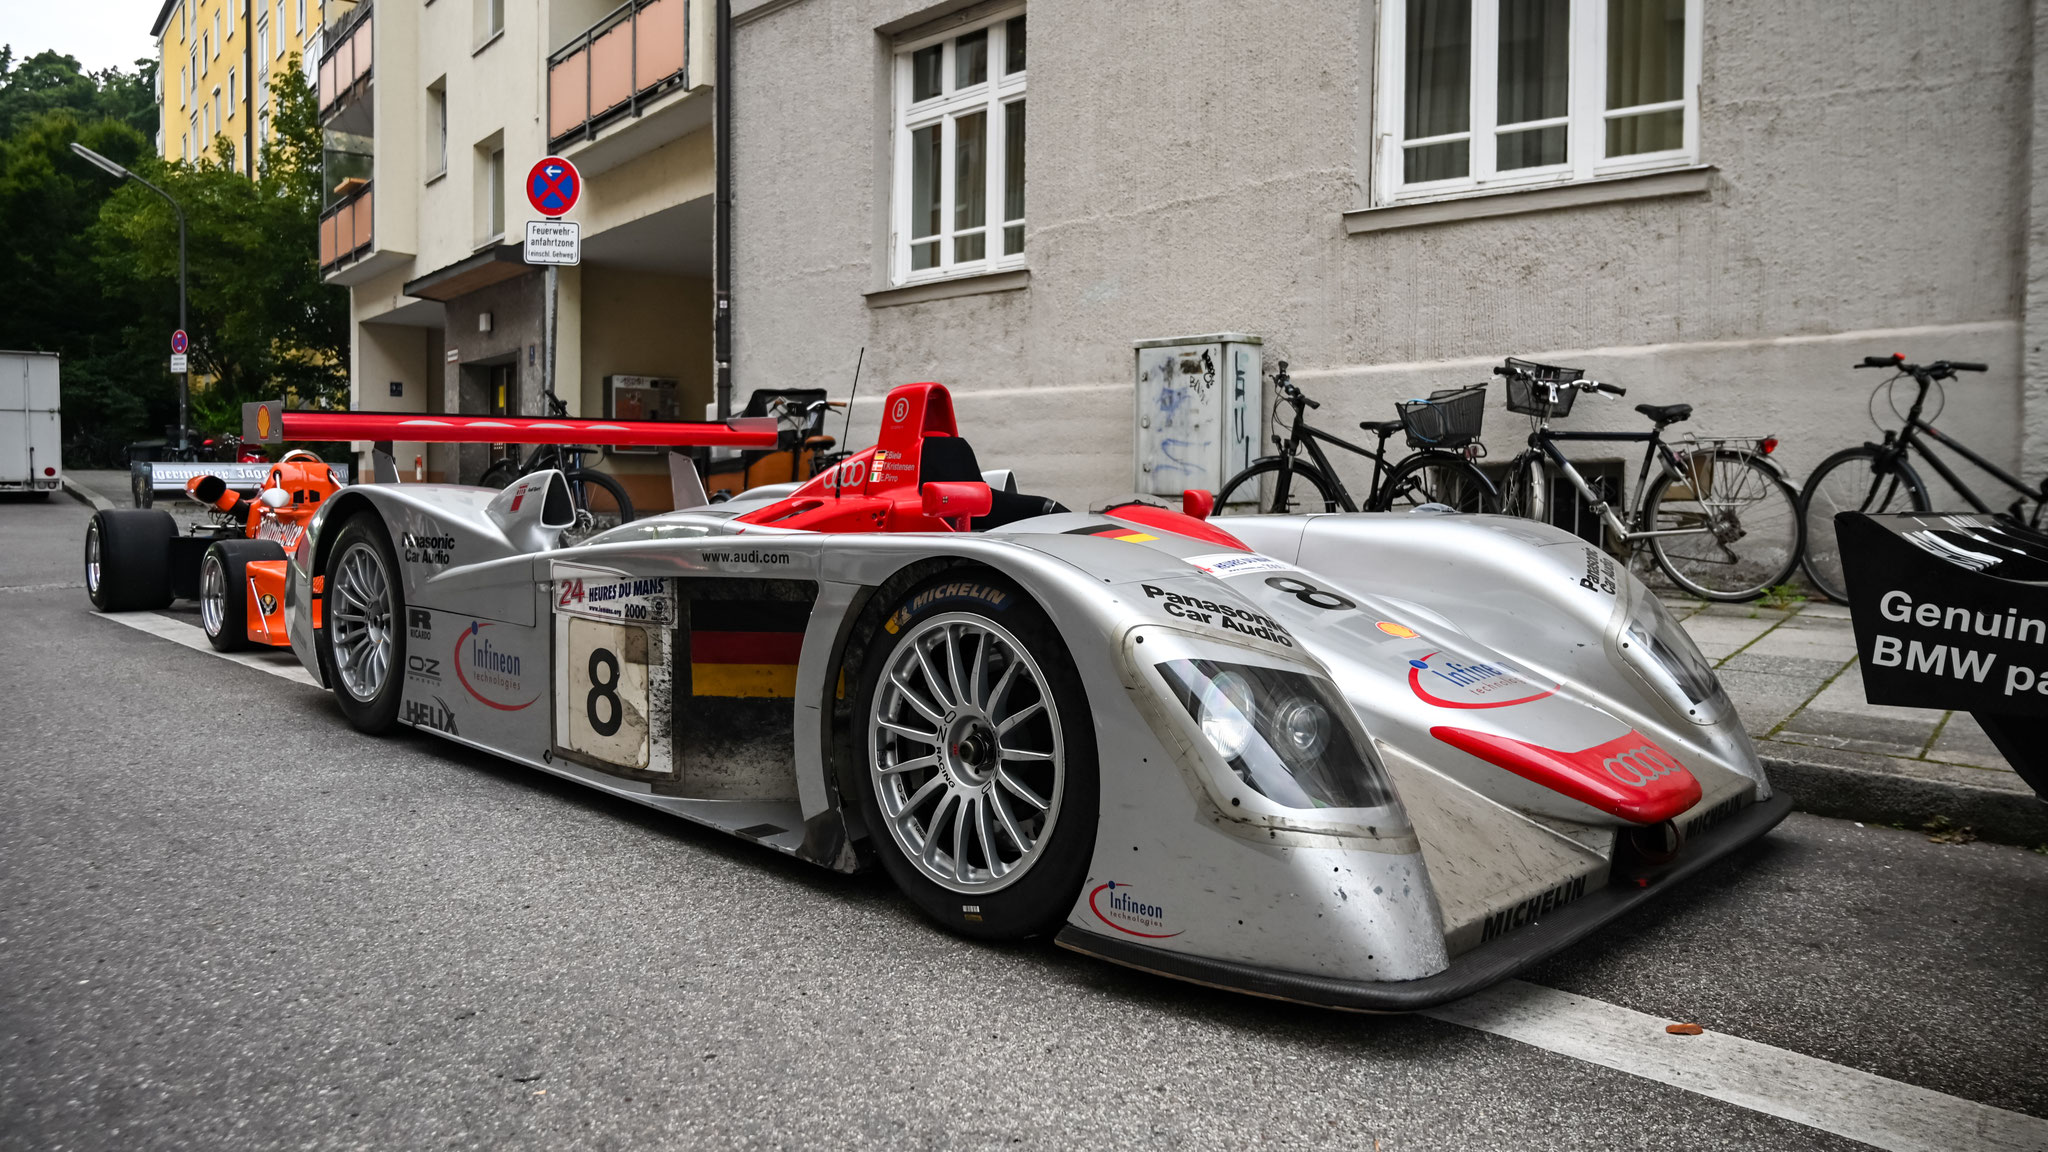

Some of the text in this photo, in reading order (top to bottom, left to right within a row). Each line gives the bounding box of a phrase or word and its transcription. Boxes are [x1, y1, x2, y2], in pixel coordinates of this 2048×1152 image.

[530, 238, 575, 248] anfahrtzone
[532, 226, 575, 236] Feuerwehr-
[402, 532, 455, 550] Panasonic
[405, 551, 450, 565] Car Audio
[702, 550, 790, 565] www.audi.com
[559, 577, 665, 607] 24 HEURES DU MANS
[913, 583, 1006, 610] MICHELIN
[1265, 577, 1356, 610] 8
[1600, 577, 1616, 595] Car
[408, 608, 432, 630] R
[624, 604, 647, 620] 2000
[1141, 584, 1292, 638] Panasonic
[1163, 602, 1292, 647] Car Audio
[410, 629, 432, 640] RICARDO
[473, 639, 521, 676] Infineon
[1872, 634, 1997, 684] BMW
[473, 671, 521, 691] technologies
[587, 647, 622, 738] 8
[406, 697, 459, 736] HELIX
[936, 746, 956, 789] RACING
[1686, 793, 1743, 840] MICHELIN
[1110, 891, 1163, 919] Infineon
[1481, 874, 1587, 943] MICHELIN
[1110, 911, 1163, 927] technologies
